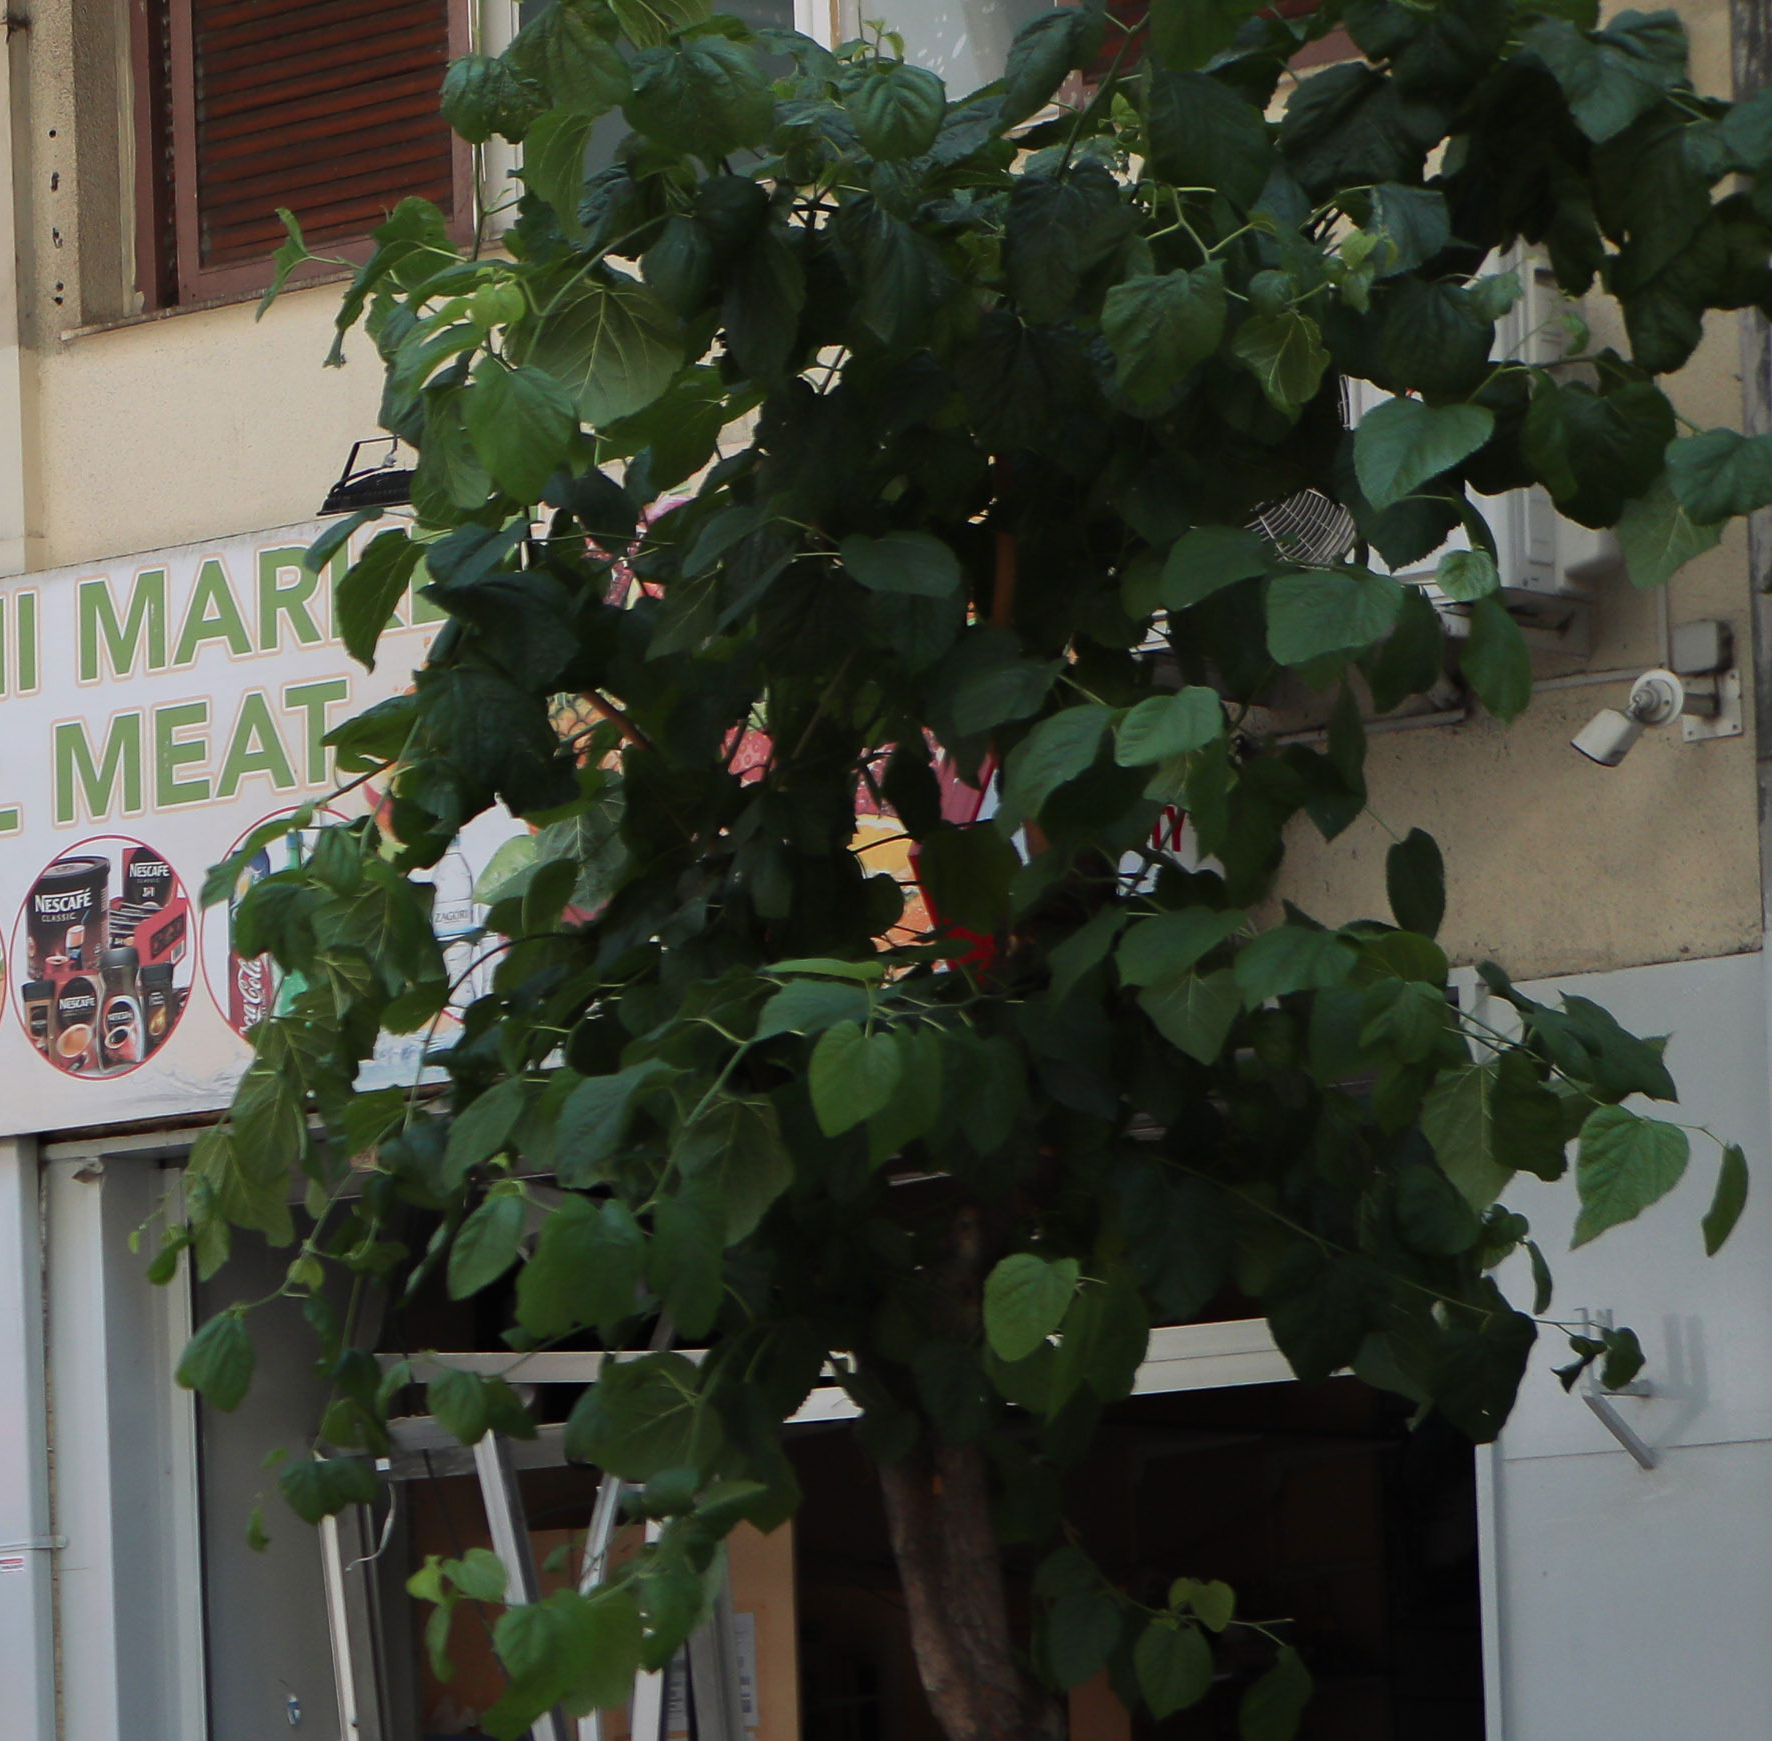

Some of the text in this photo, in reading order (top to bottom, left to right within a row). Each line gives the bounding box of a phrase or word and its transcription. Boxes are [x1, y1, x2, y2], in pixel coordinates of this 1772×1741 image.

[78, 515, 517, 684] MAR
[56, 678, 350, 824] MEAT
[41, 911, 77, 923] CLASSIC
